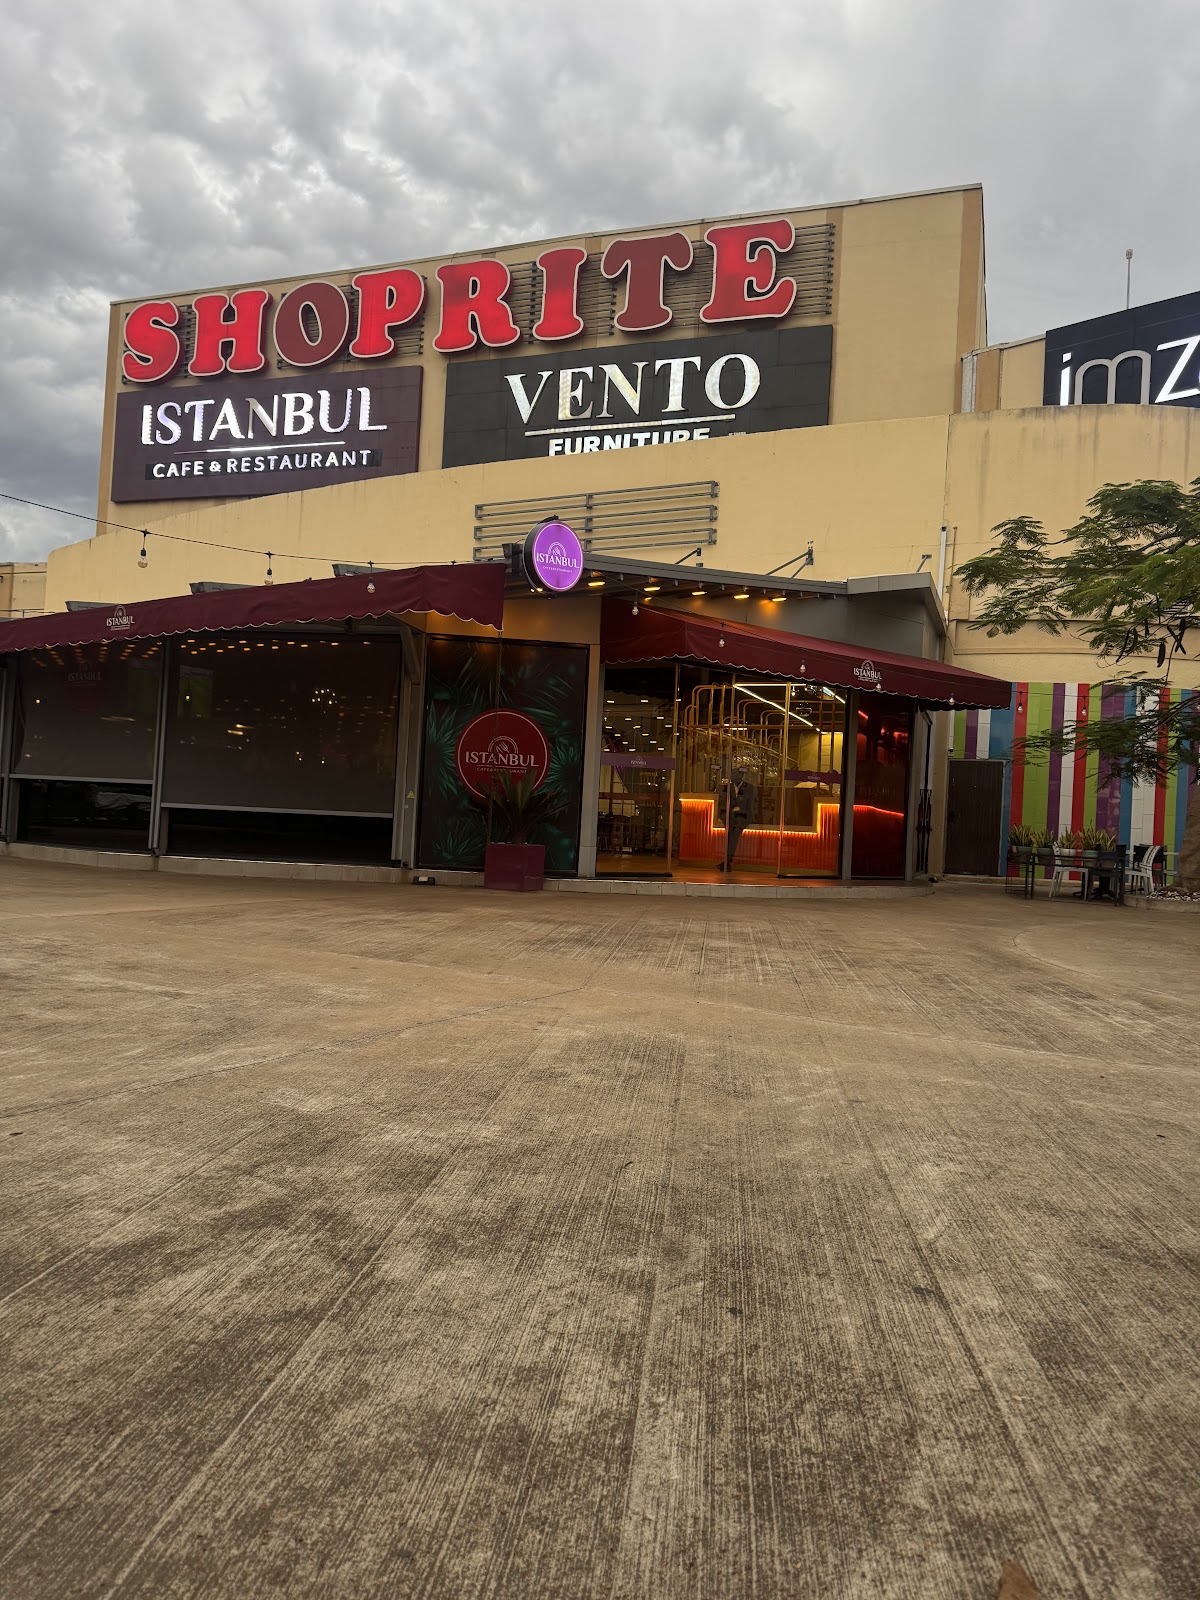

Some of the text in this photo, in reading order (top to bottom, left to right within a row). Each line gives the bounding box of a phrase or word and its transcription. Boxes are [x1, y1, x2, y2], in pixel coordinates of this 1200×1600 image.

[122, 217, 797, 383] SHOPRITE
[1060, 335, 1200, 405] imZ
[505, 353, 760, 424] VENTO
[141, 387, 387, 445] ISTANBUL
[152, 461, 204, 478] CAFE
[226, 450, 372, 472] RESTAURANT
[537, 553, 579, 568] ISTANBUL
[106, 616, 135, 626] ISTANBUL
[854, 668, 882, 679] ISTANBUL
[466, 751, 539, 766] ISTANBUL
